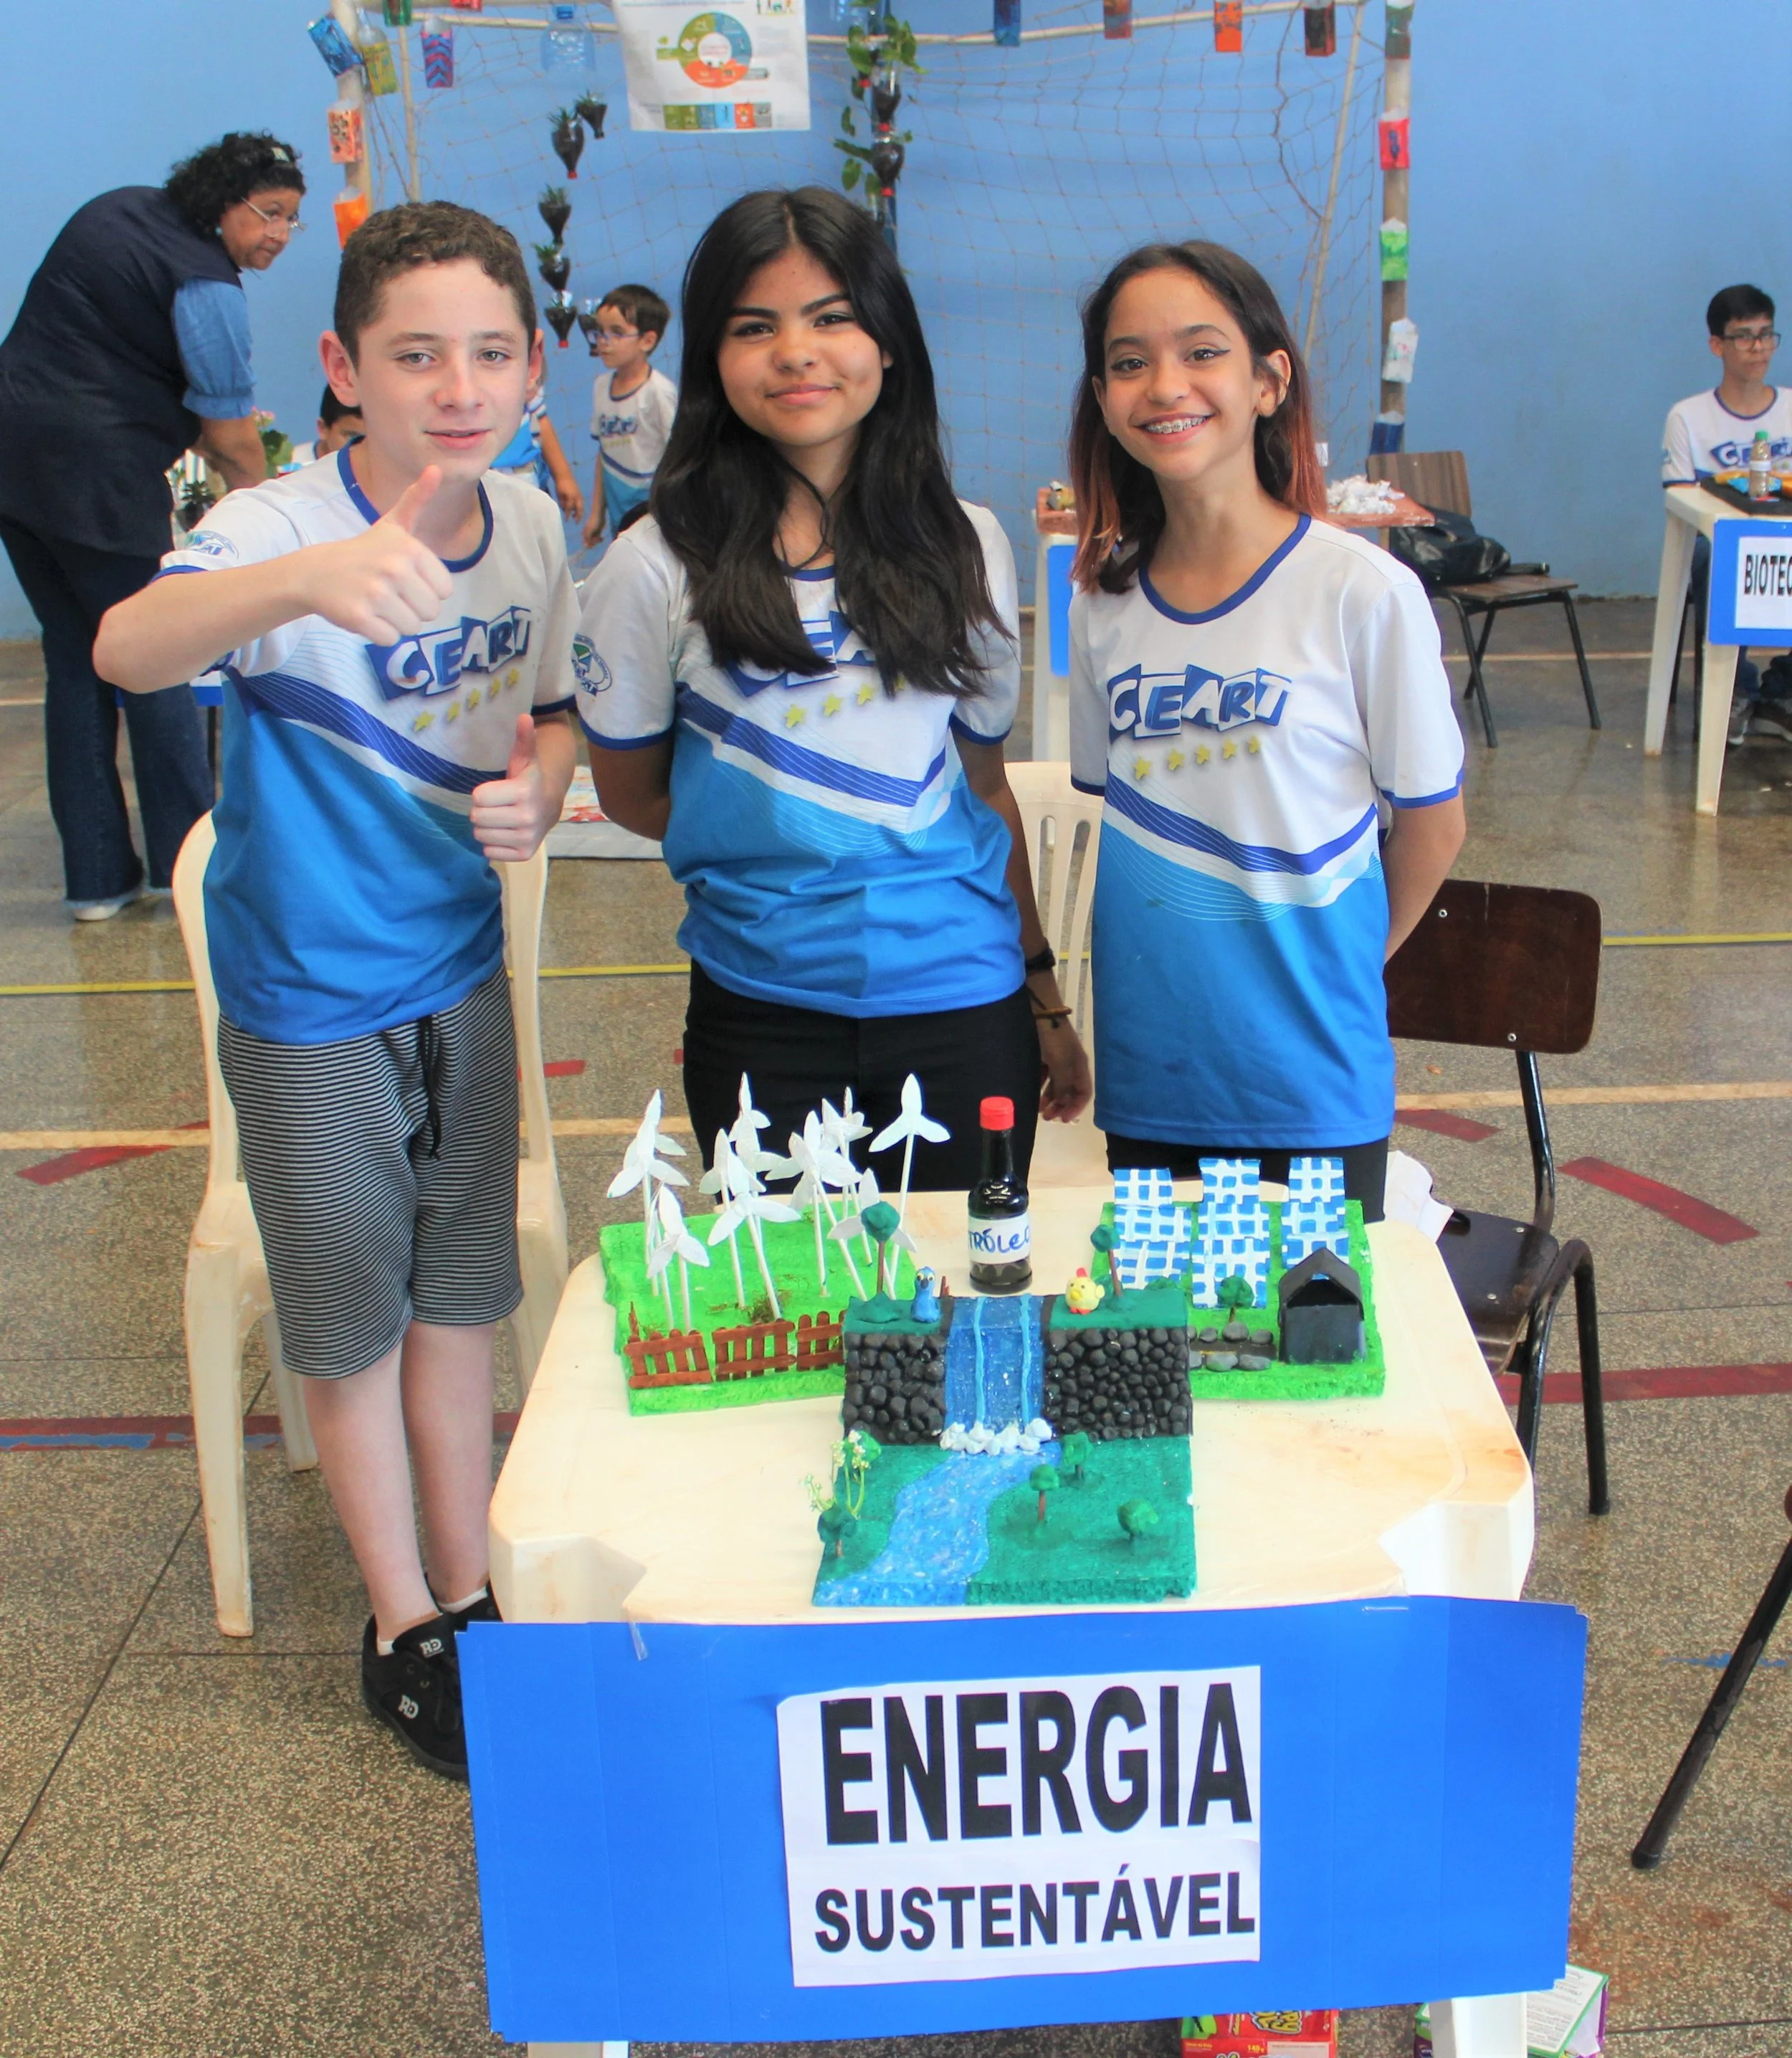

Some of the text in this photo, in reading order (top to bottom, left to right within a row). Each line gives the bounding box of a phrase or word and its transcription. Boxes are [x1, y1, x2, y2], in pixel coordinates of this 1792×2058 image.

[378, 606, 531, 697] CEART
[1108, 665, 1292, 738] CEART
[821, 1682, 1252, 1846] ENERGIA
[814, 1864, 1255, 1952] SUSTENTÁVEL
